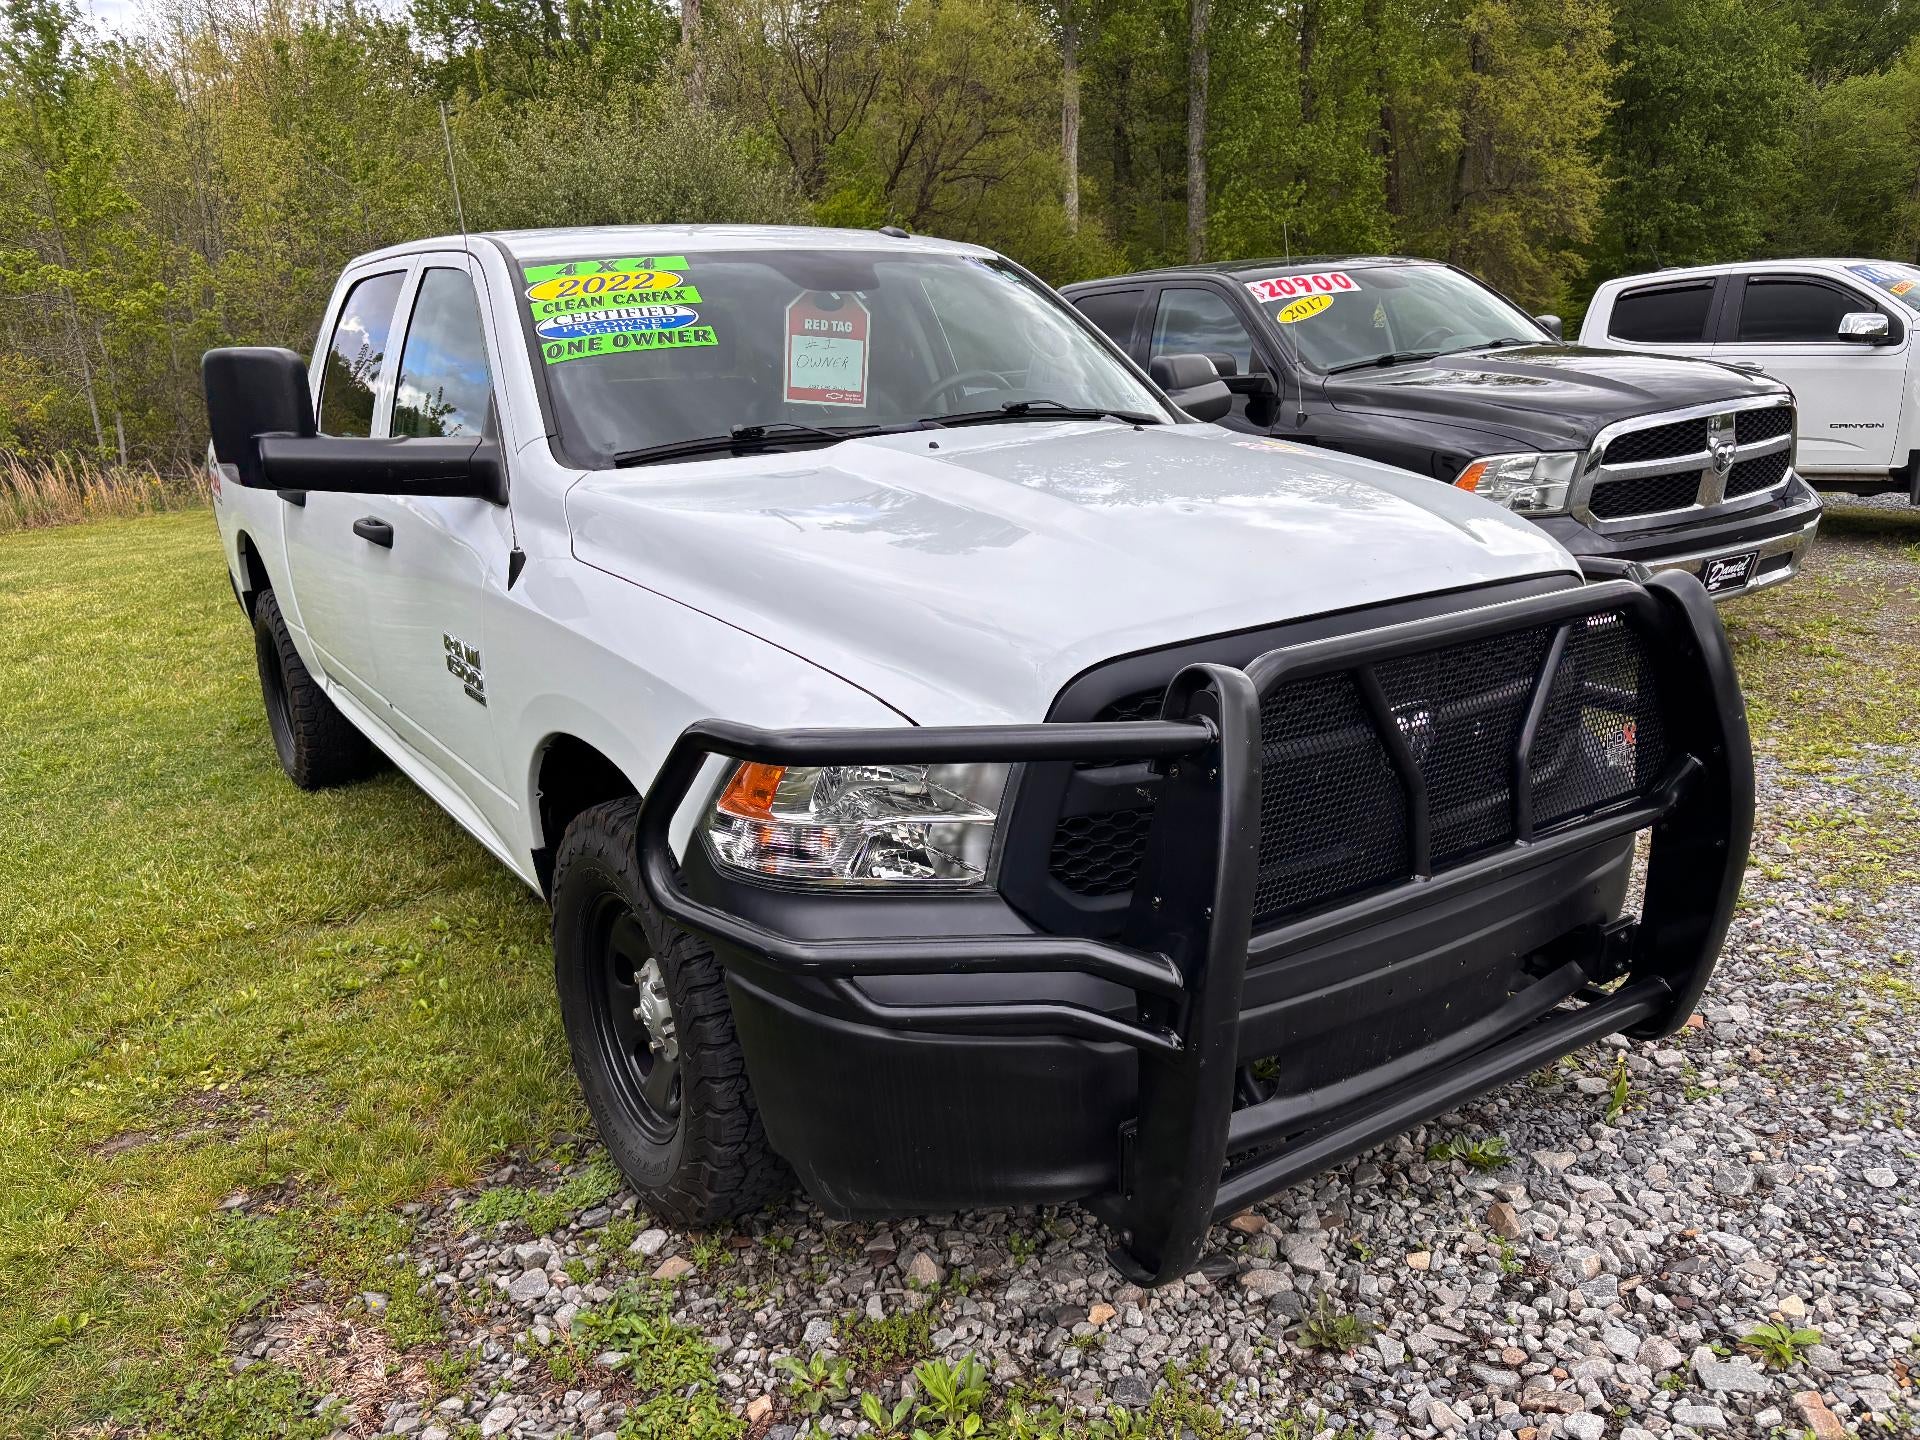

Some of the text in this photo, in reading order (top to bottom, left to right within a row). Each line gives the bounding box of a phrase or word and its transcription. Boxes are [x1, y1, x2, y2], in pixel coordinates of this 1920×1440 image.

[555, 272, 656, 299] 2022
[1251, 273, 1353, 300] $20900
[542, 289, 686, 314] CLEAN CARFAX
[1285, 296, 1324, 320] 2017
[553, 305, 679, 326] CERTIFIED
[562, 317, 676, 333] PRE-OWNED
[804, 318, 853, 332] RED TAG
[583, 323, 663, 336] VEHICLE
[546, 329, 712, 359] ONE OWNER
[796, 354, 849, 369] OWNER
[1709, 557, 1750, 583] Daniel
[443, 632, 481, 670] RAM
[446, 654, 484, 693] 1500
